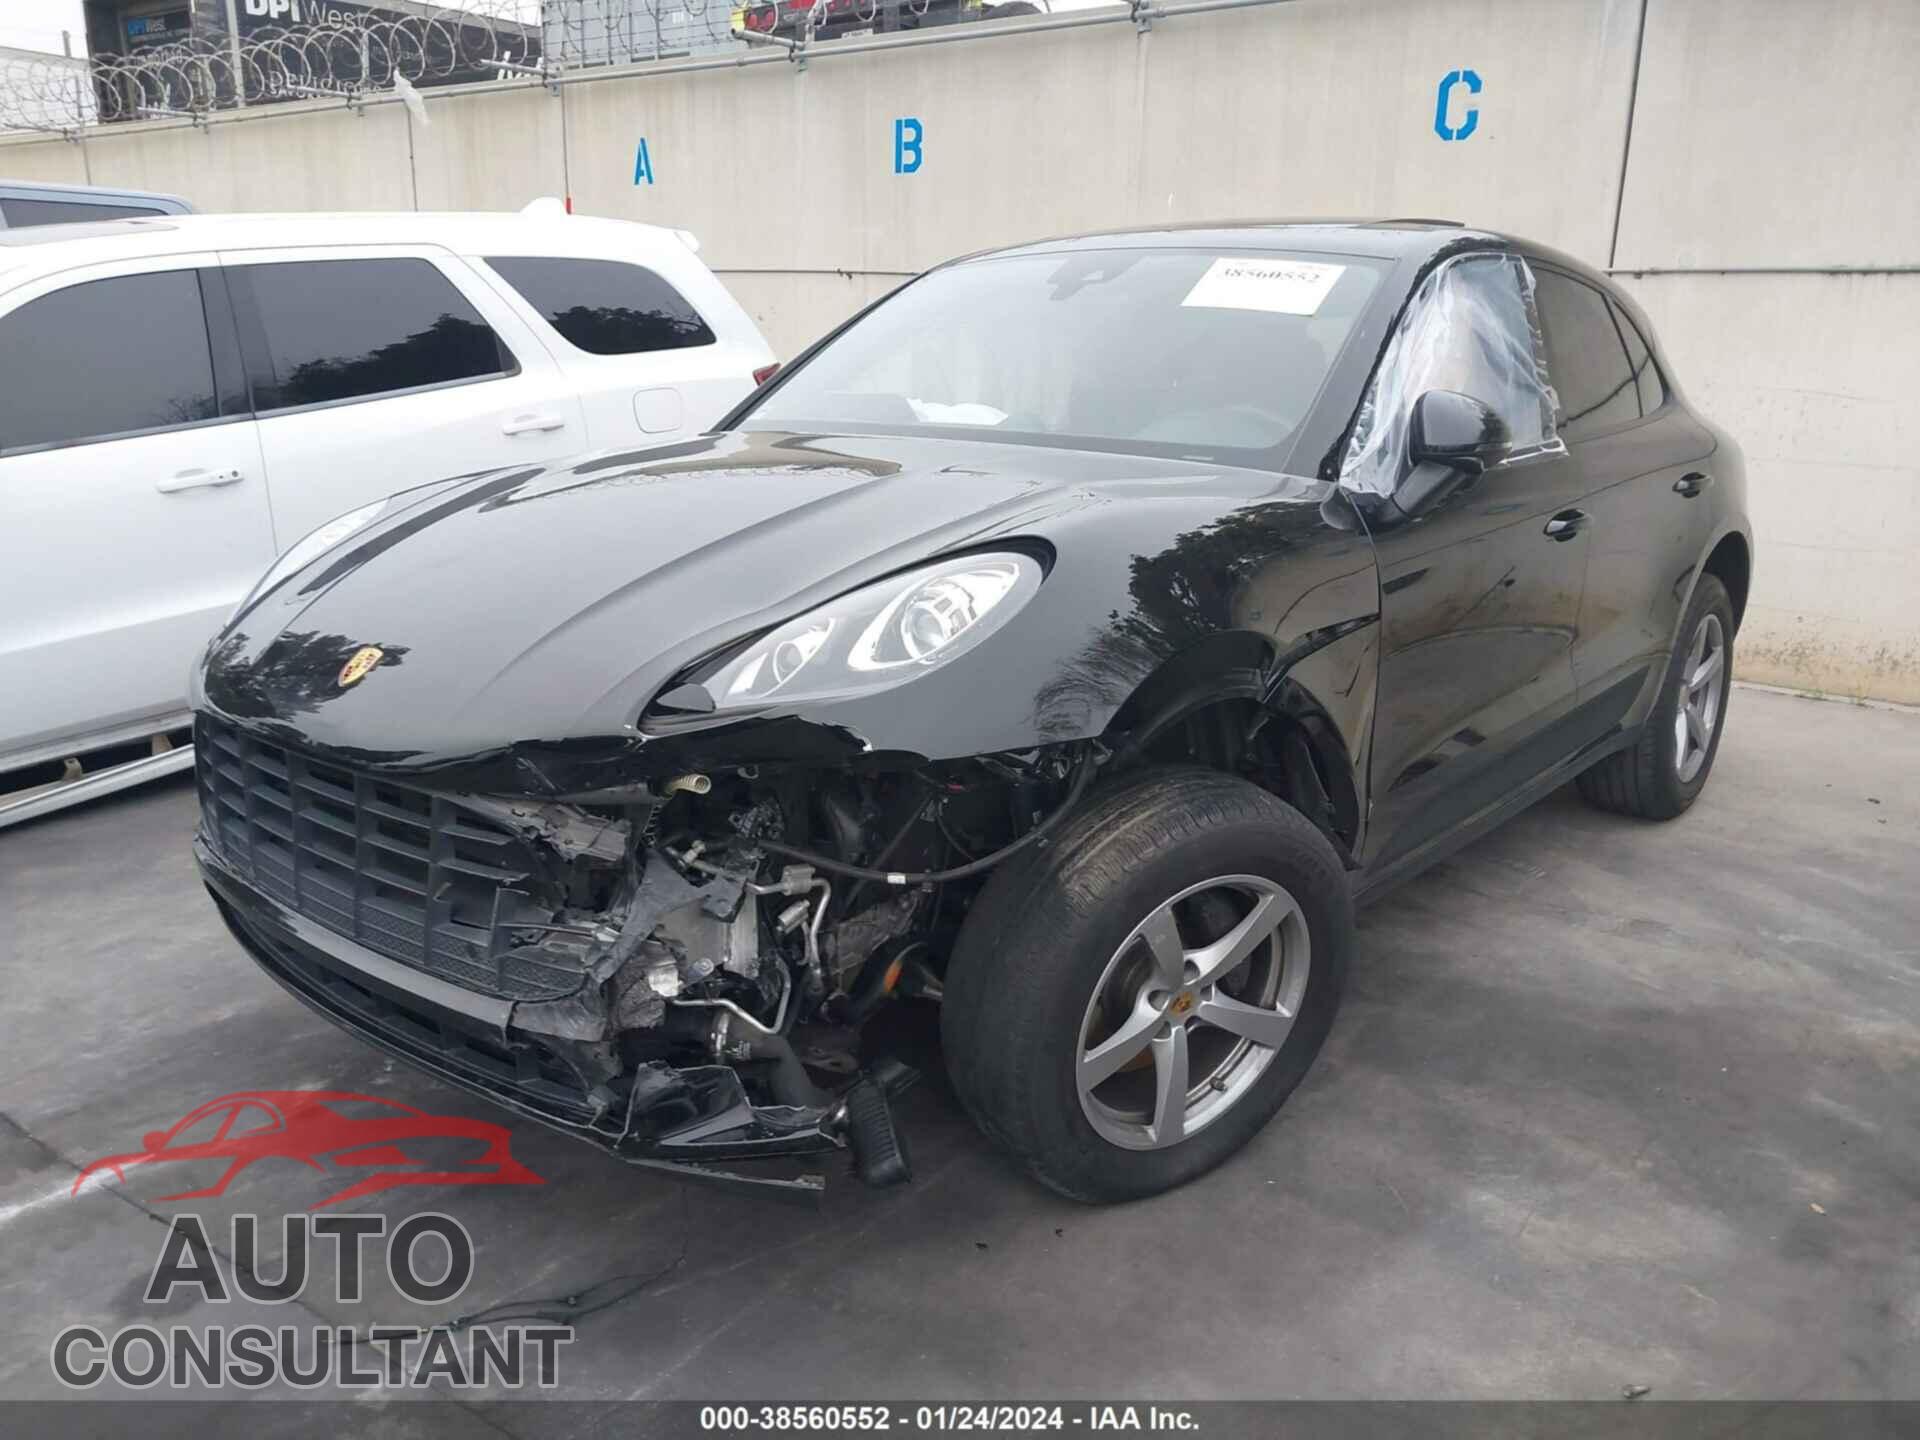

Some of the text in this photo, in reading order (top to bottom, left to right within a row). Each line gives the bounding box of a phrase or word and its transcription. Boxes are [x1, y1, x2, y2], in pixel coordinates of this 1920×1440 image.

[1434, 70, 1482, 141] C
[634, 137, 653, 185] A
[895, 118, 922, 173] B
